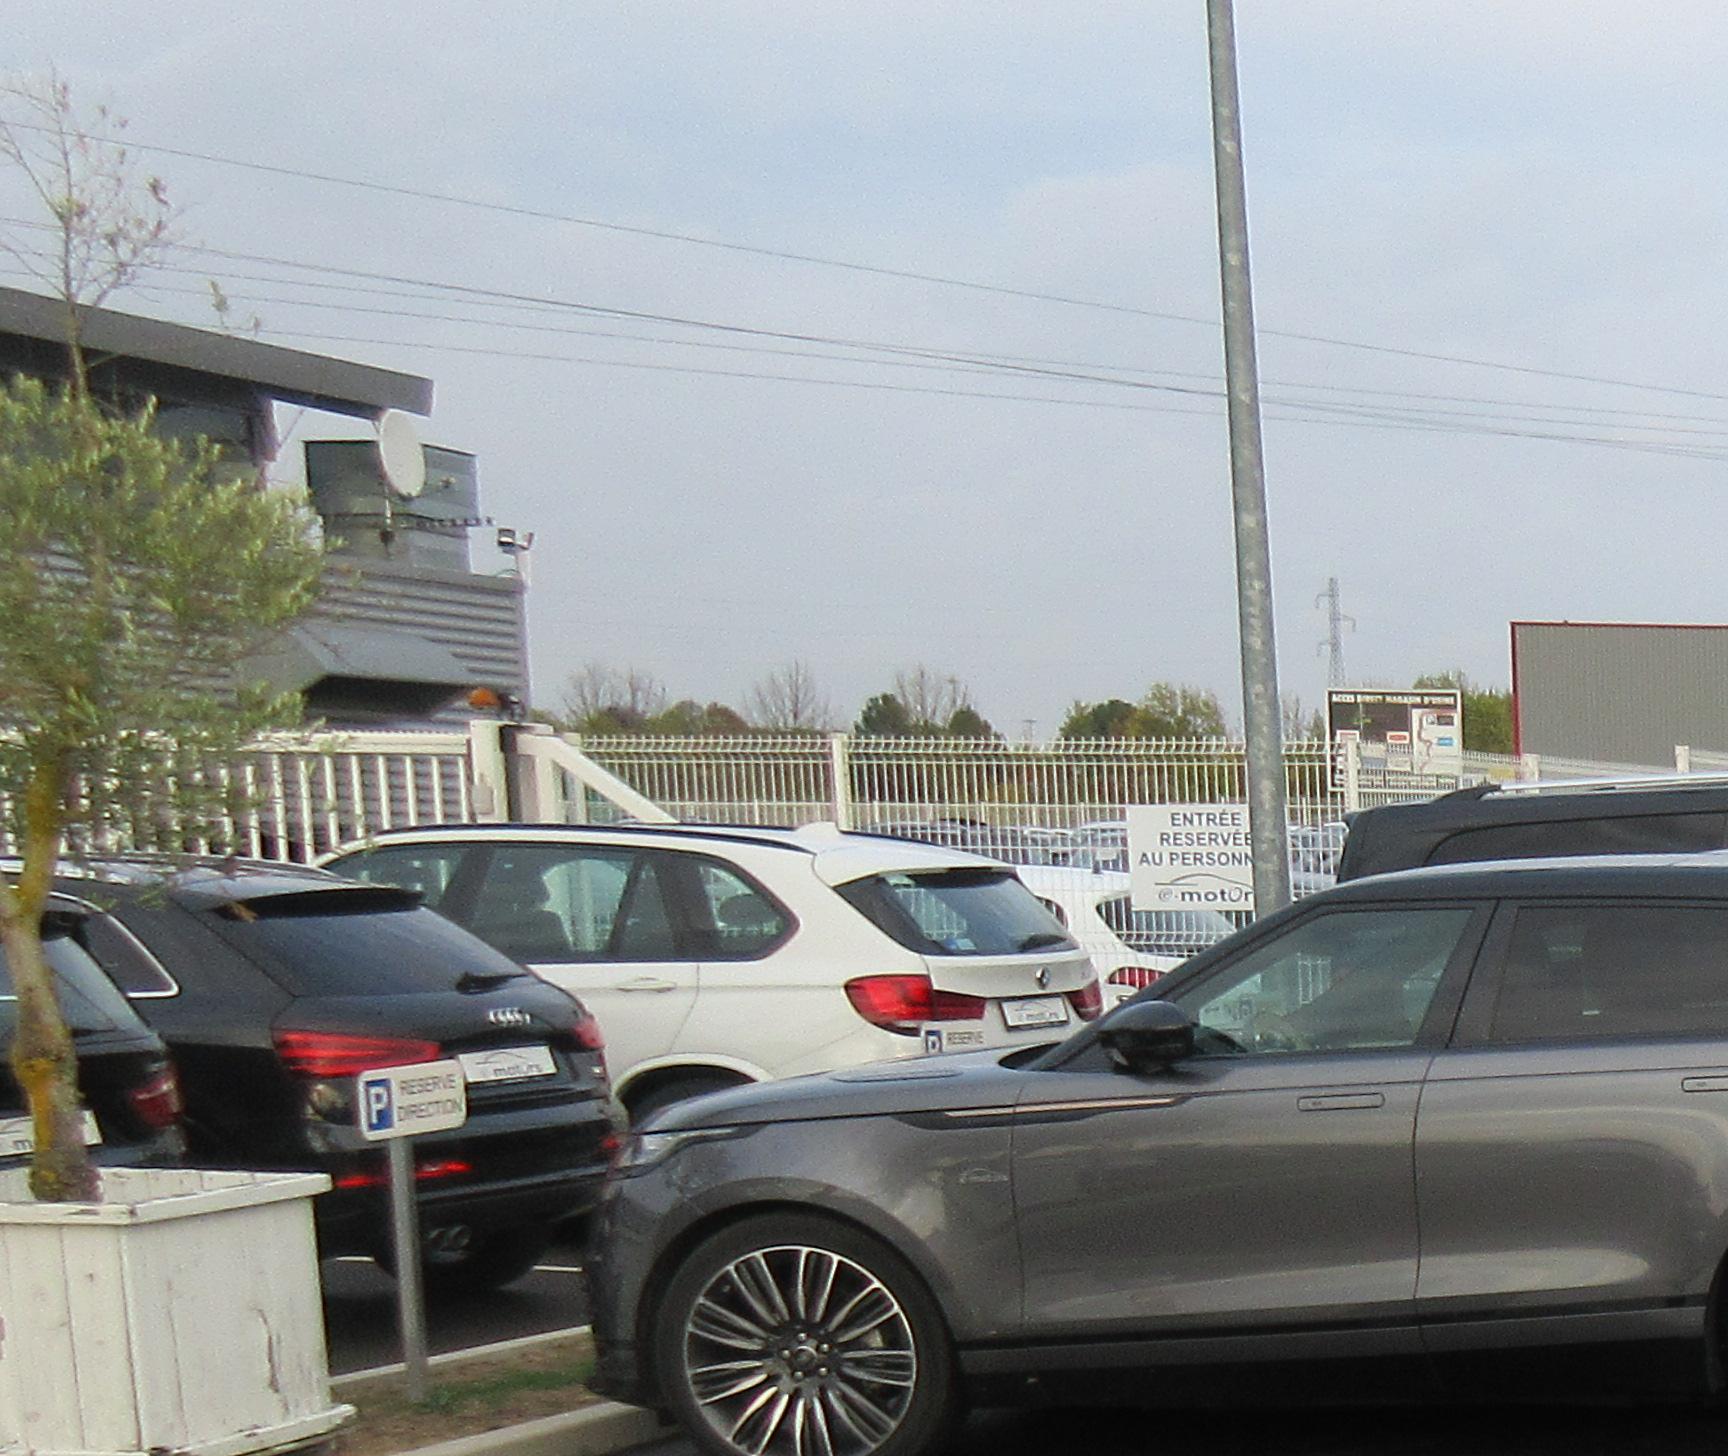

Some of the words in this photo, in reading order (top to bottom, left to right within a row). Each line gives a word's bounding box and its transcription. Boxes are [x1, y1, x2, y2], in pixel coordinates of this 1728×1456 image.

[1170, 810, 1242, 826] ENTRÉE
[1139, 852, 1163, 866] AU
[1169, 852, 1253, 866] PERSONN
[1158, 886, 1253, 903] e-motor
[397, 1099, 464, 1121] DIRECTION
